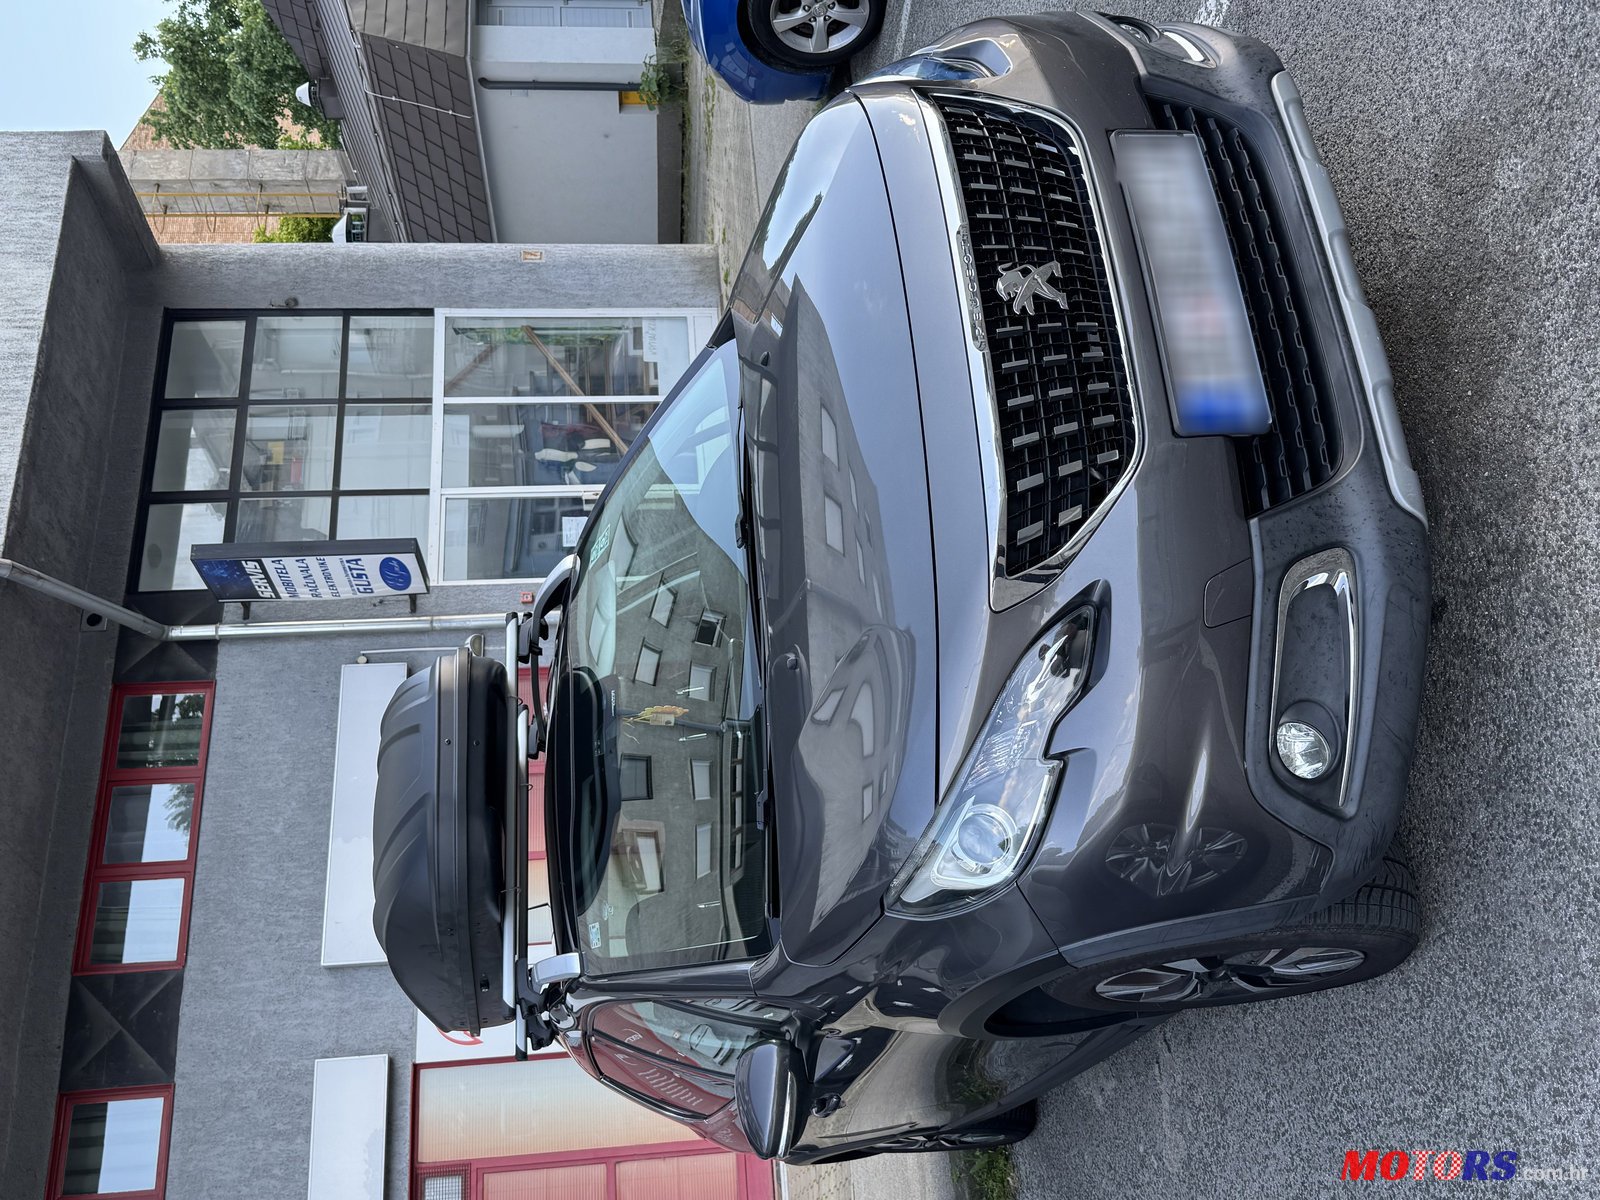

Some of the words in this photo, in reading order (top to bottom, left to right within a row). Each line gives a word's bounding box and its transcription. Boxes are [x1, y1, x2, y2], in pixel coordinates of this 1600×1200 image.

[960, 240, 985, 336] PEUGEOT
[241, 560, 276, 598] SERVIS
[271, 559, 301, 598] MOBITELA
[295, 558, 323, 598] RAČUNALA
[316, 557, 341, 597] ELEKTRONIKE
[345, 557, 374, 594] GUSTA
